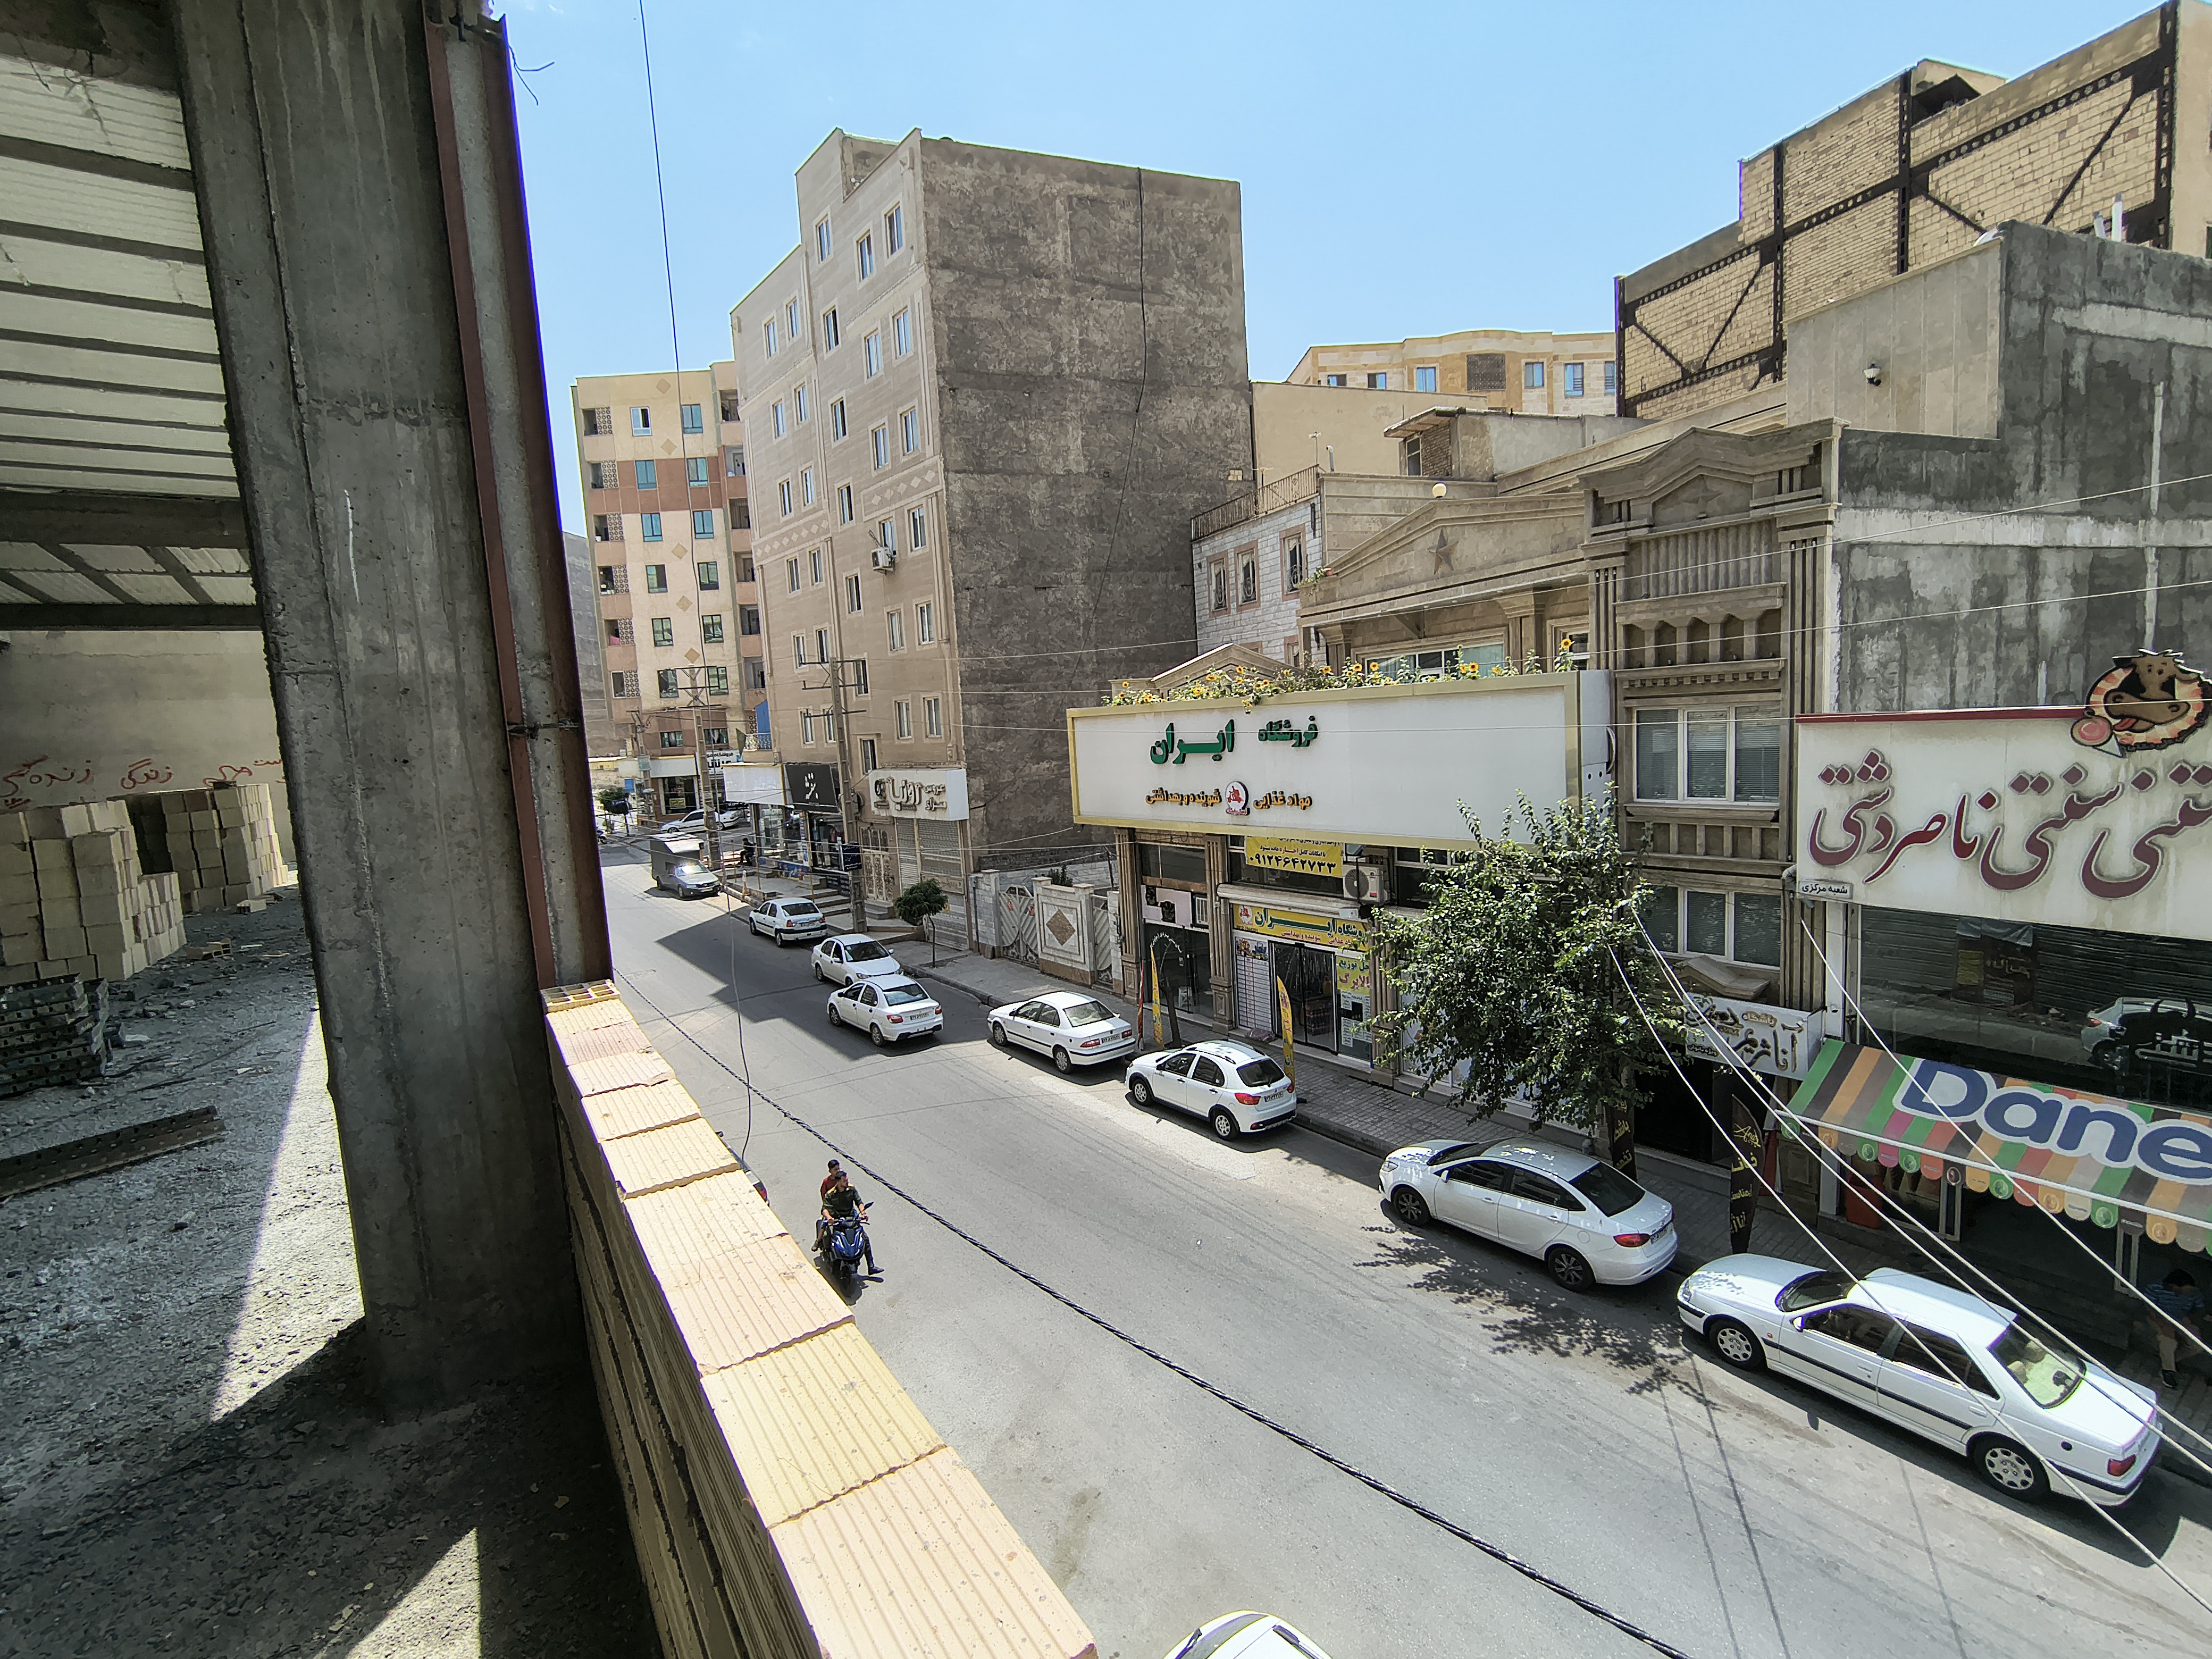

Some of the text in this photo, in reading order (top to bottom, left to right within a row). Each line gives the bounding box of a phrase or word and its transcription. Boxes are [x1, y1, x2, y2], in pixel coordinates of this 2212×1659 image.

[1150, 715, 1318, 764] فروشگاه ایران
[1145, 787, 1183, 806] بهداشتی
[1190, 789, 1222, 807] شوینده
[1253, 791, 1286, 810] غذایی
[1287, 793, 1312, 810] مواد
[1802, 883, 1848, 895] شعبه مرکزی
[1255, 907, 1364, 938] وشگاه ایران
[1339, 959, 1370, 972] حل توزیع
